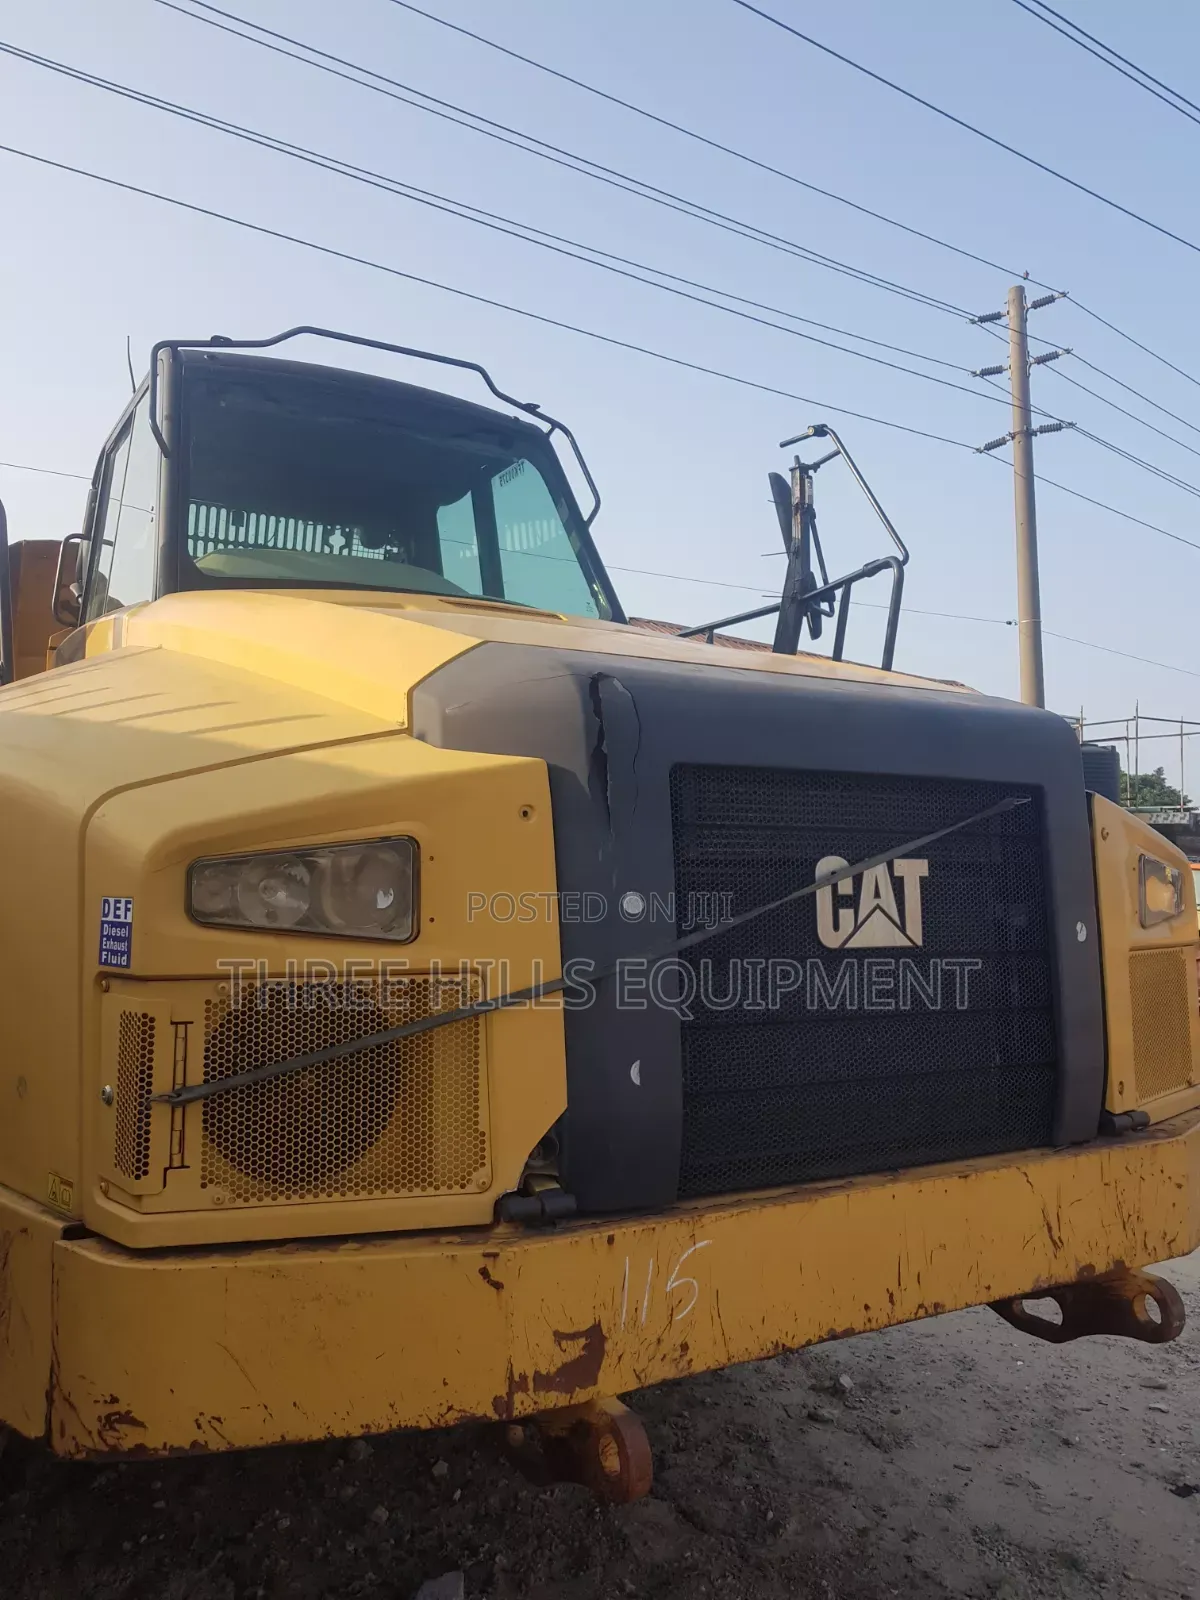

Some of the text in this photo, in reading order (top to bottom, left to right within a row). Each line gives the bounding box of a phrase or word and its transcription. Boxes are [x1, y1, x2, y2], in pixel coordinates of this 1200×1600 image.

[102, 898, 132, 920] DEF
[815, 855, 929, 949] CAT
[103, 924, 129, 938] Diesel
[102, 937, 128, 952] Exhaust
[101, 951, 128, 966] Fluid
[621, 1239, 713, 1331] 115
